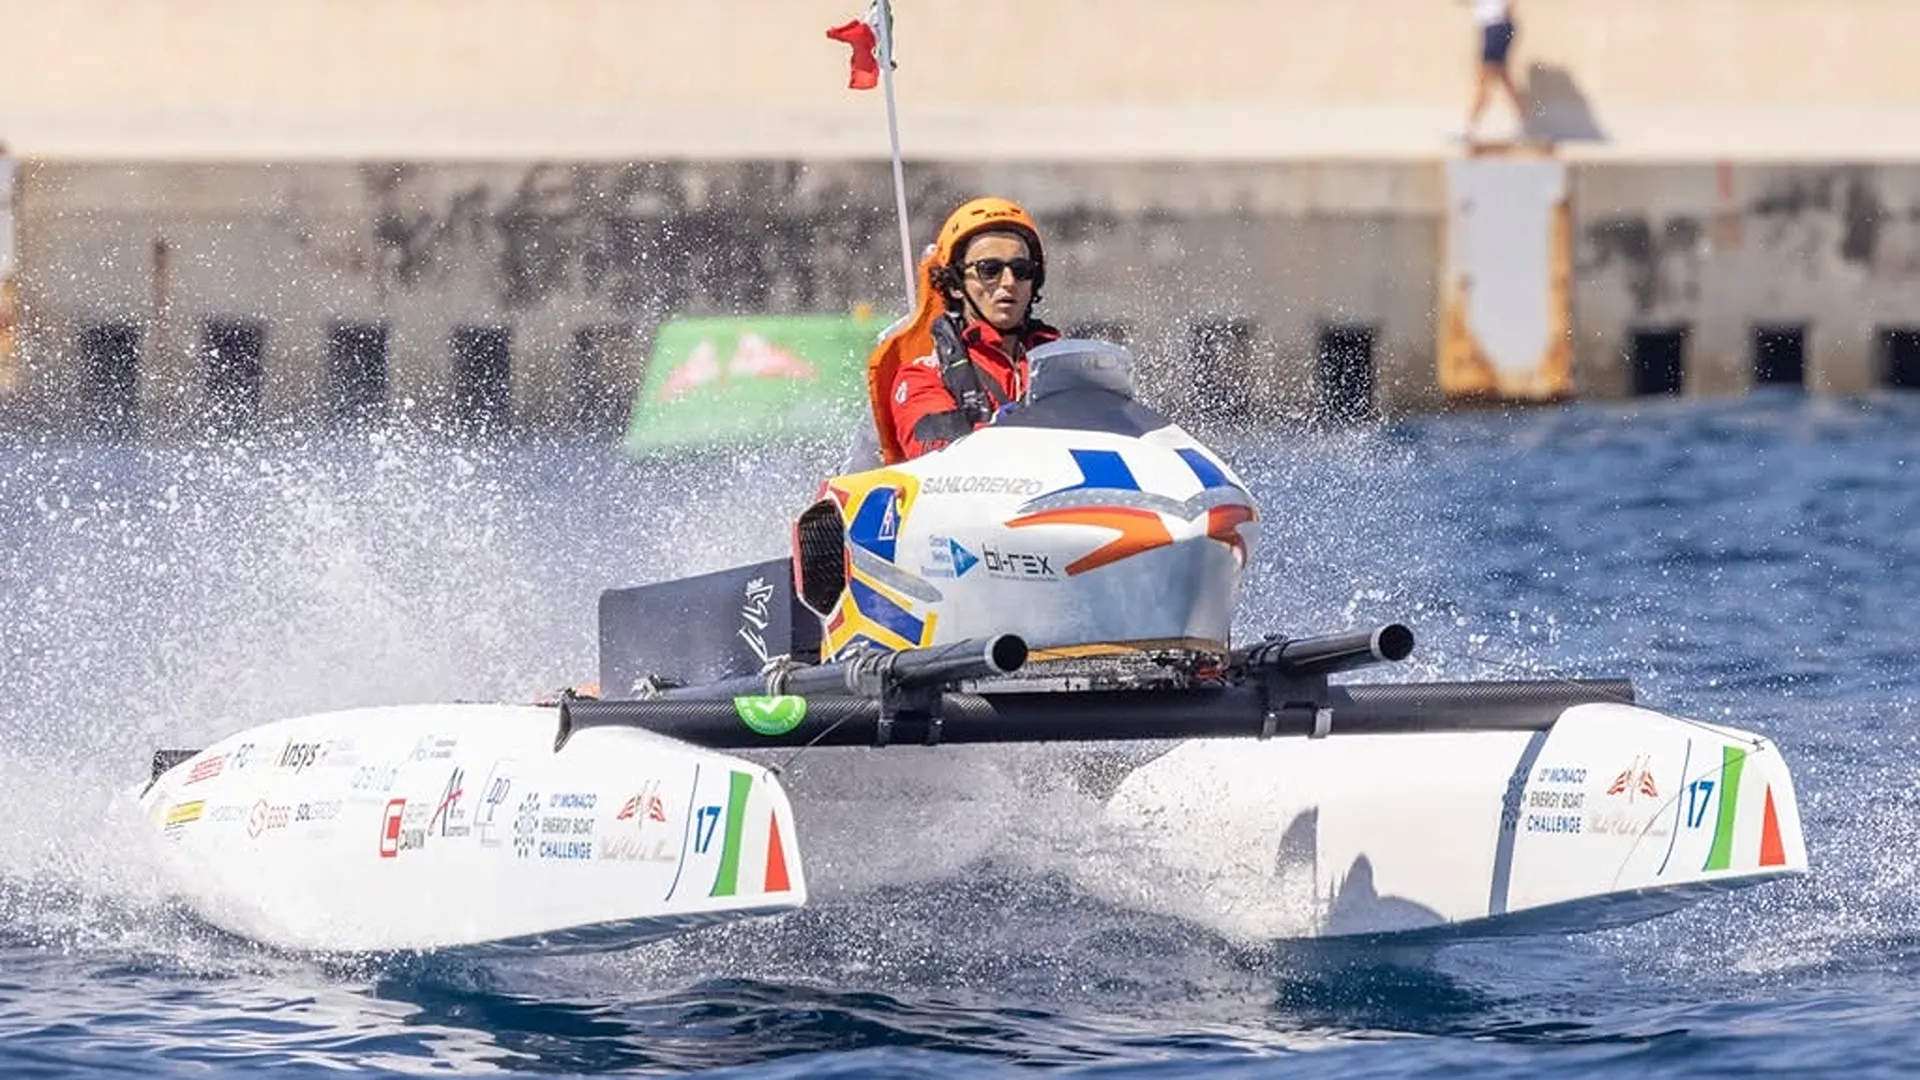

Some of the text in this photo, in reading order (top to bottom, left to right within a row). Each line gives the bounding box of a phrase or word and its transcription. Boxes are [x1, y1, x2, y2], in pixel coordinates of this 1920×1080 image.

[921, 475, 1043, 496] SANLORENZO
[1550, 767, 1587, 785] MONACO
[560, 793, 597, 809] MONACO
[1530, 790, 1585, 809] ENERGY BOAT
[1686, 780, 1715, 829] 17
[541, 816, 595, 835] ENERGY BOAT
[695, 805, 722, 855] 17
[1527, 813, 1582, 834] CHALLENGE
[539, 840, 593, 860] CHALLENGE
